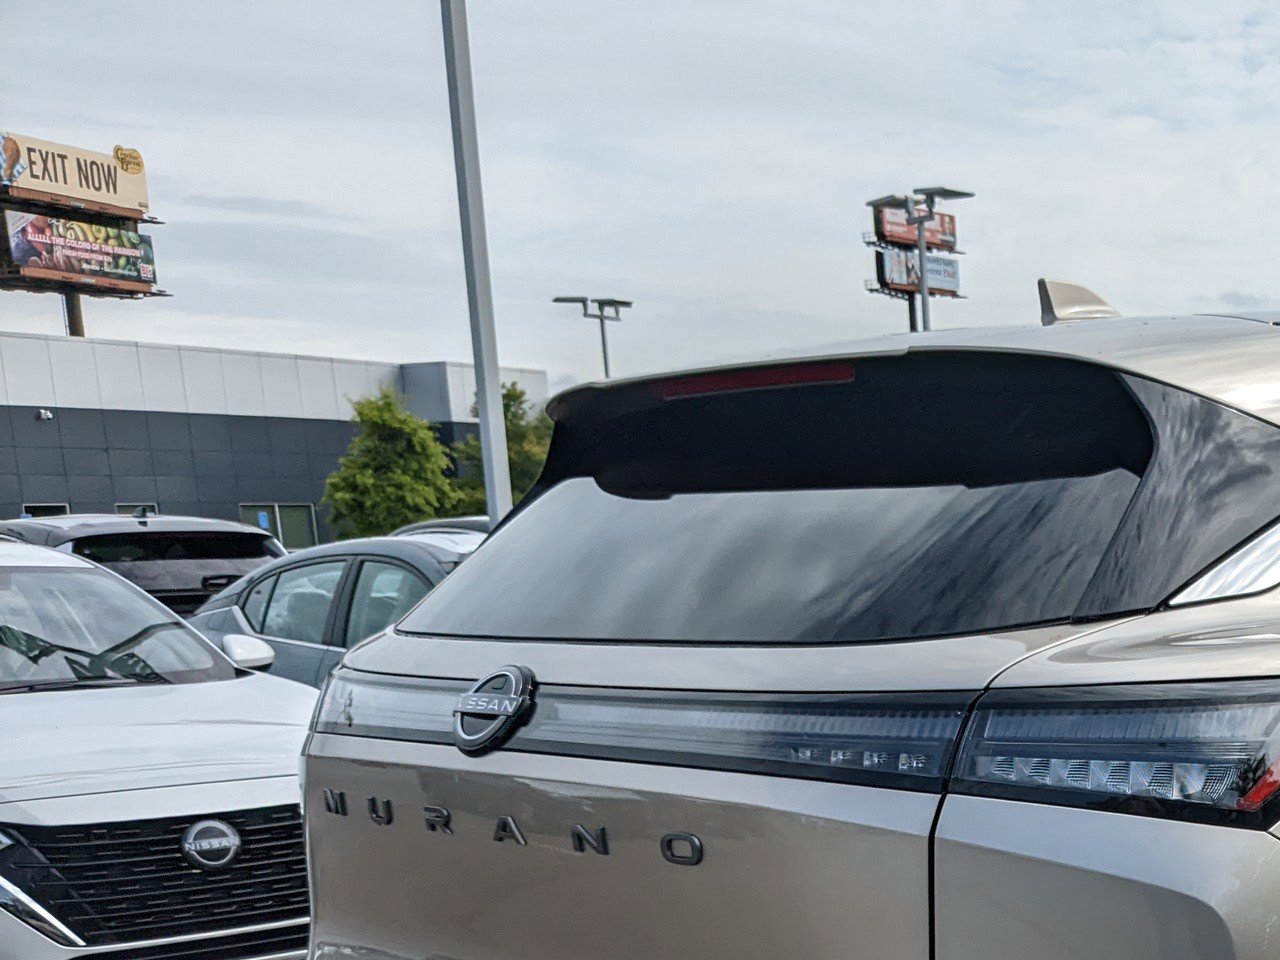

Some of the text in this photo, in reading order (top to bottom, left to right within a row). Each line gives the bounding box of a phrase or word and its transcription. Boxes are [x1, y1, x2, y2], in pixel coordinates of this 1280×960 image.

[26, 146, 118, 195] EXIT NOW
[457, 697, 518, 712] ISSAN
[323, 788, 704, 866] MURANO
[184, 836, 240, 852] NISSAN
